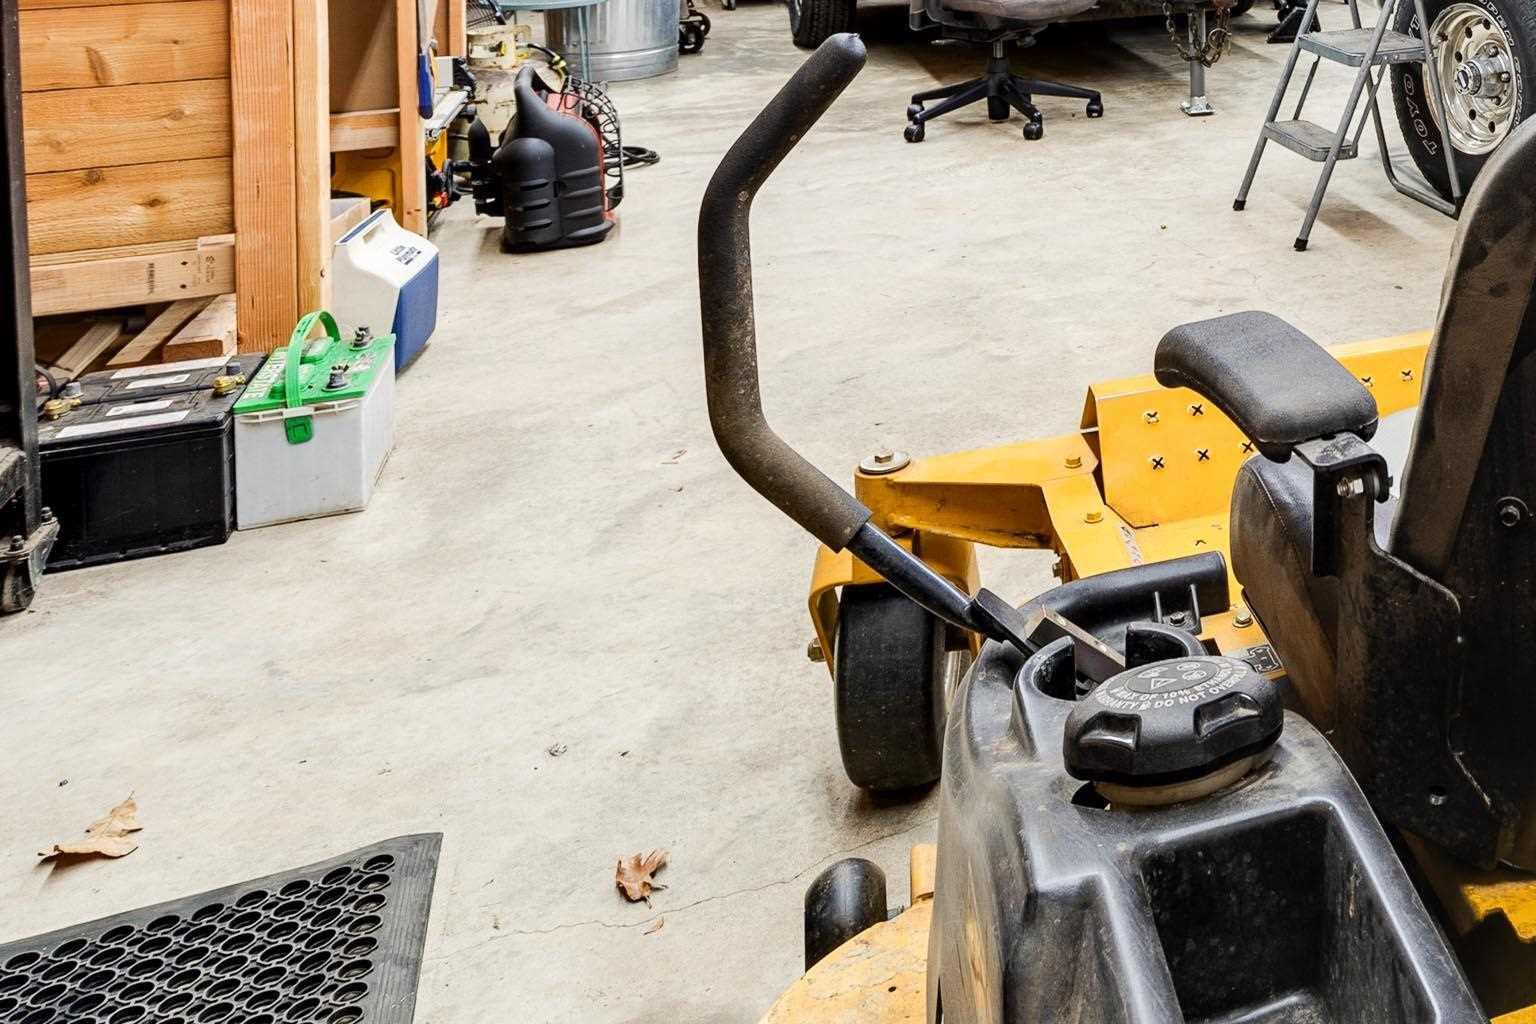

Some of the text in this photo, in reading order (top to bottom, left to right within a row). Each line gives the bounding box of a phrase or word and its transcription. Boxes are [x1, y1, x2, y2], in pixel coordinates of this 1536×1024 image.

[1403, 73, 1437, 156] TOYO
[1154, 699, 1175, 709] DO
[1179, 691, 1206, 705] NOT
